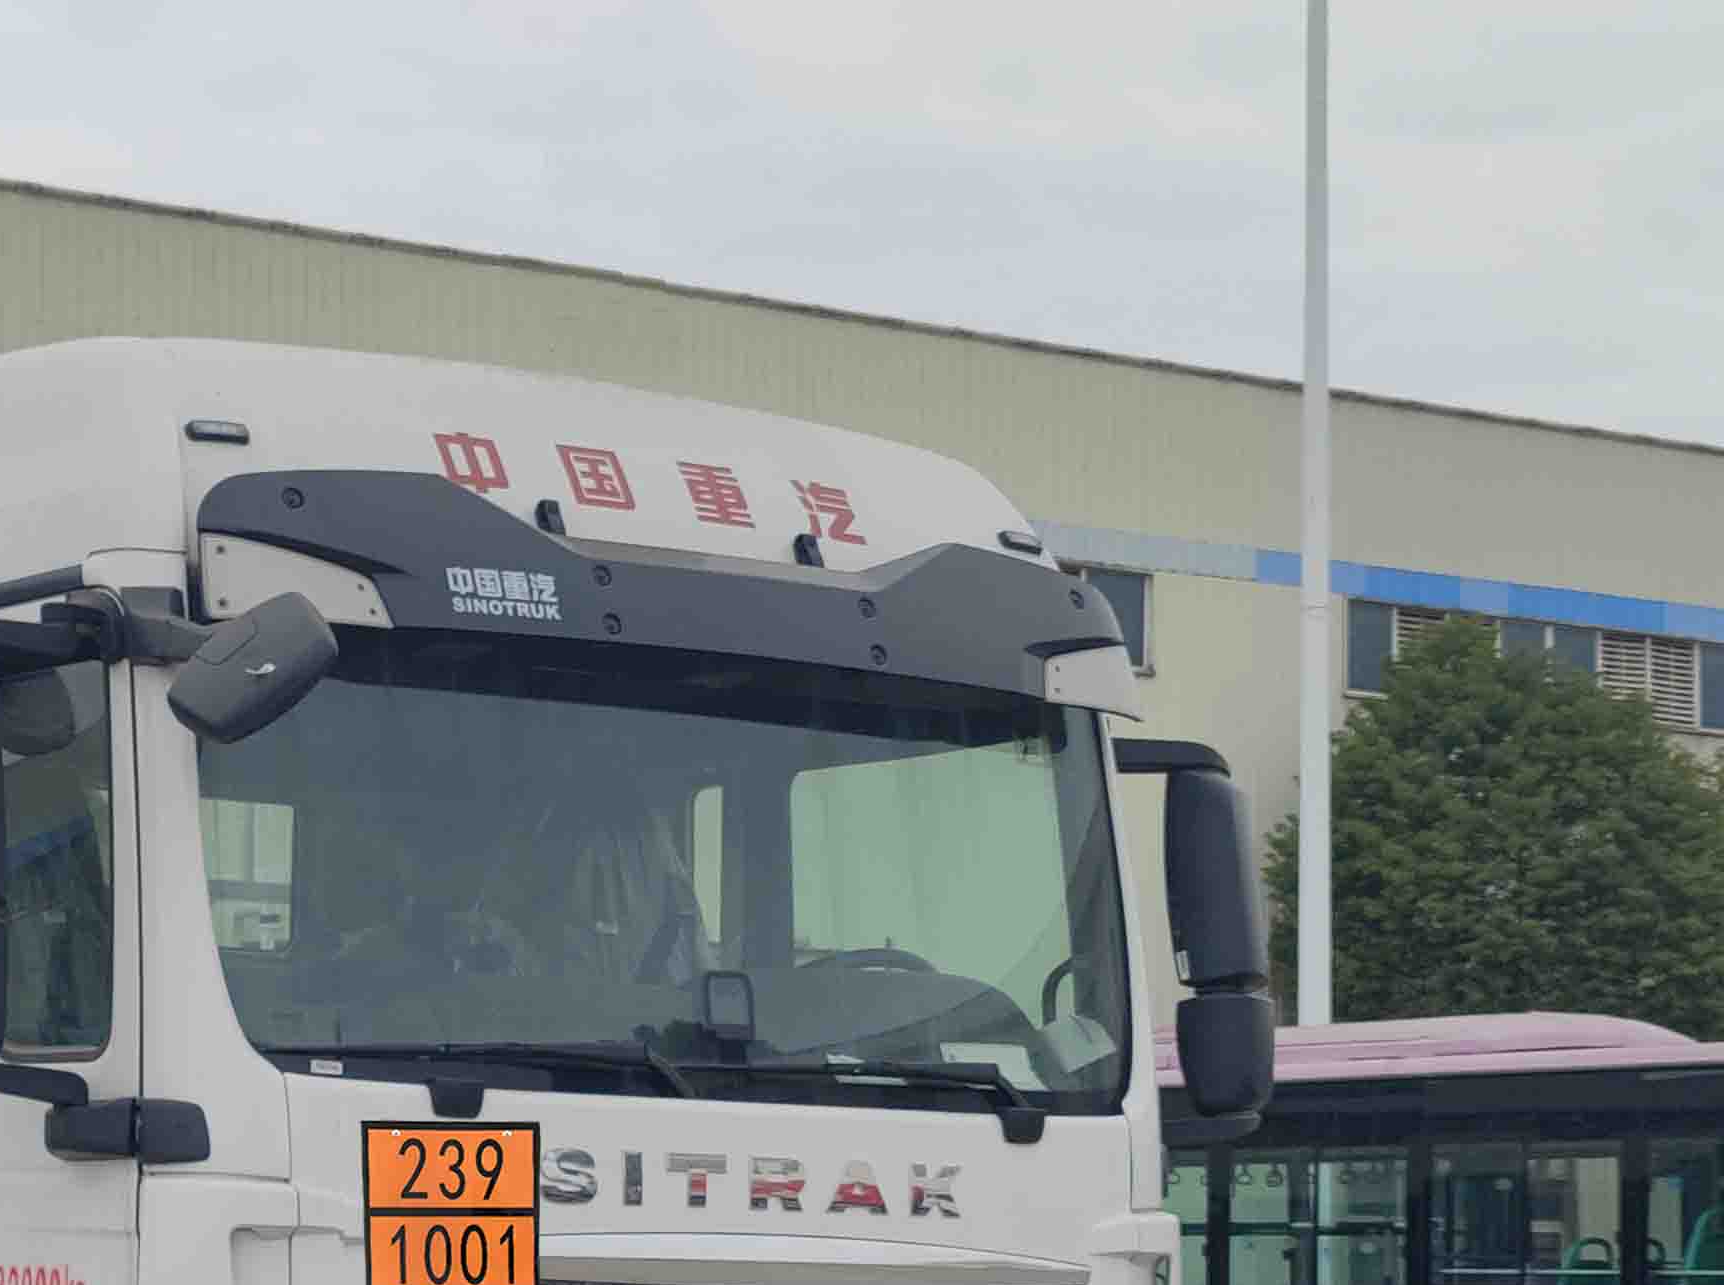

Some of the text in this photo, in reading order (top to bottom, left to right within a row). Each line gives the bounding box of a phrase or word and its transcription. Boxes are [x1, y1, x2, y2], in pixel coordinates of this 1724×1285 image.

[432, 431, 868, 546] 中国重汽
[444, 566, 560, 603] 中国重汽
[451, 595, 563, 621] SINOTRUK
[397, 1137, 505, 1201] 239
[541, 1147, 962, 1218] SITRAK
[389, 1223, 516, 1285] 1001
